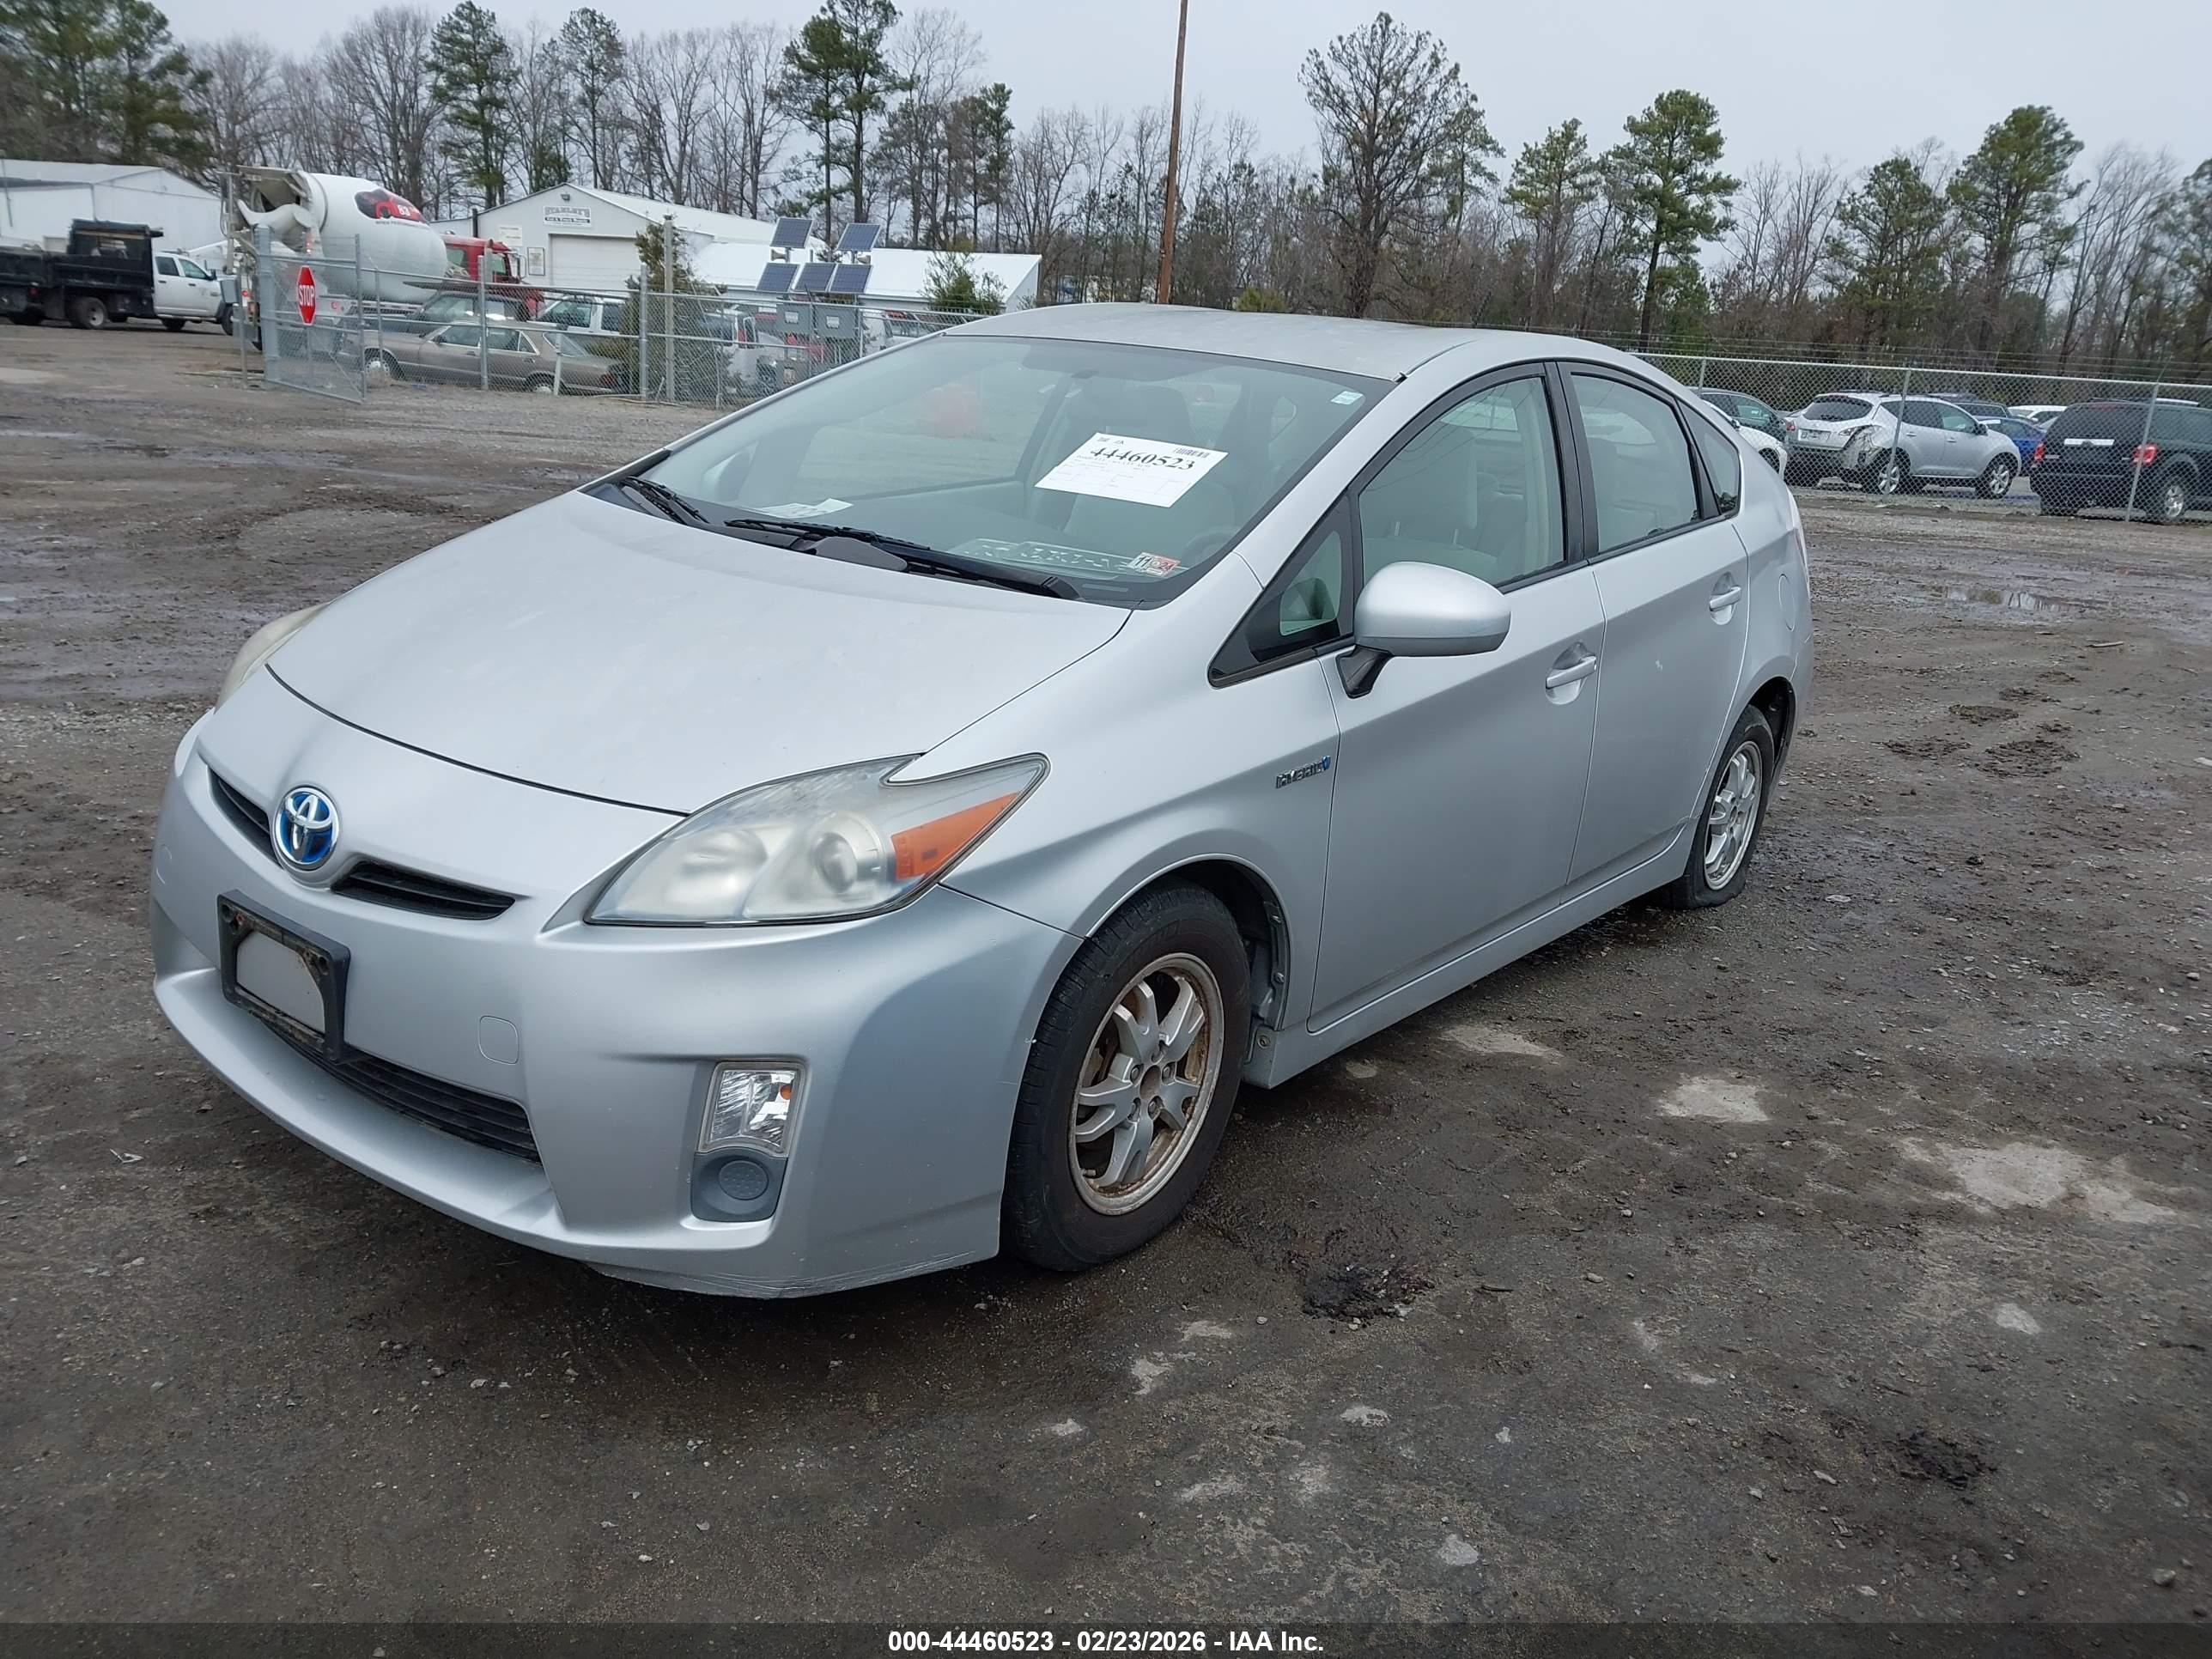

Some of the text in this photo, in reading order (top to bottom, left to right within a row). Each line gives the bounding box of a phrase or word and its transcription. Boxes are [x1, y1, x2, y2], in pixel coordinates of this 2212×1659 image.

[299, 284, 315, 307] STOP
[1091, 447, 1196, 471] 44460523
[1134, 556, 1152, 568] 11
